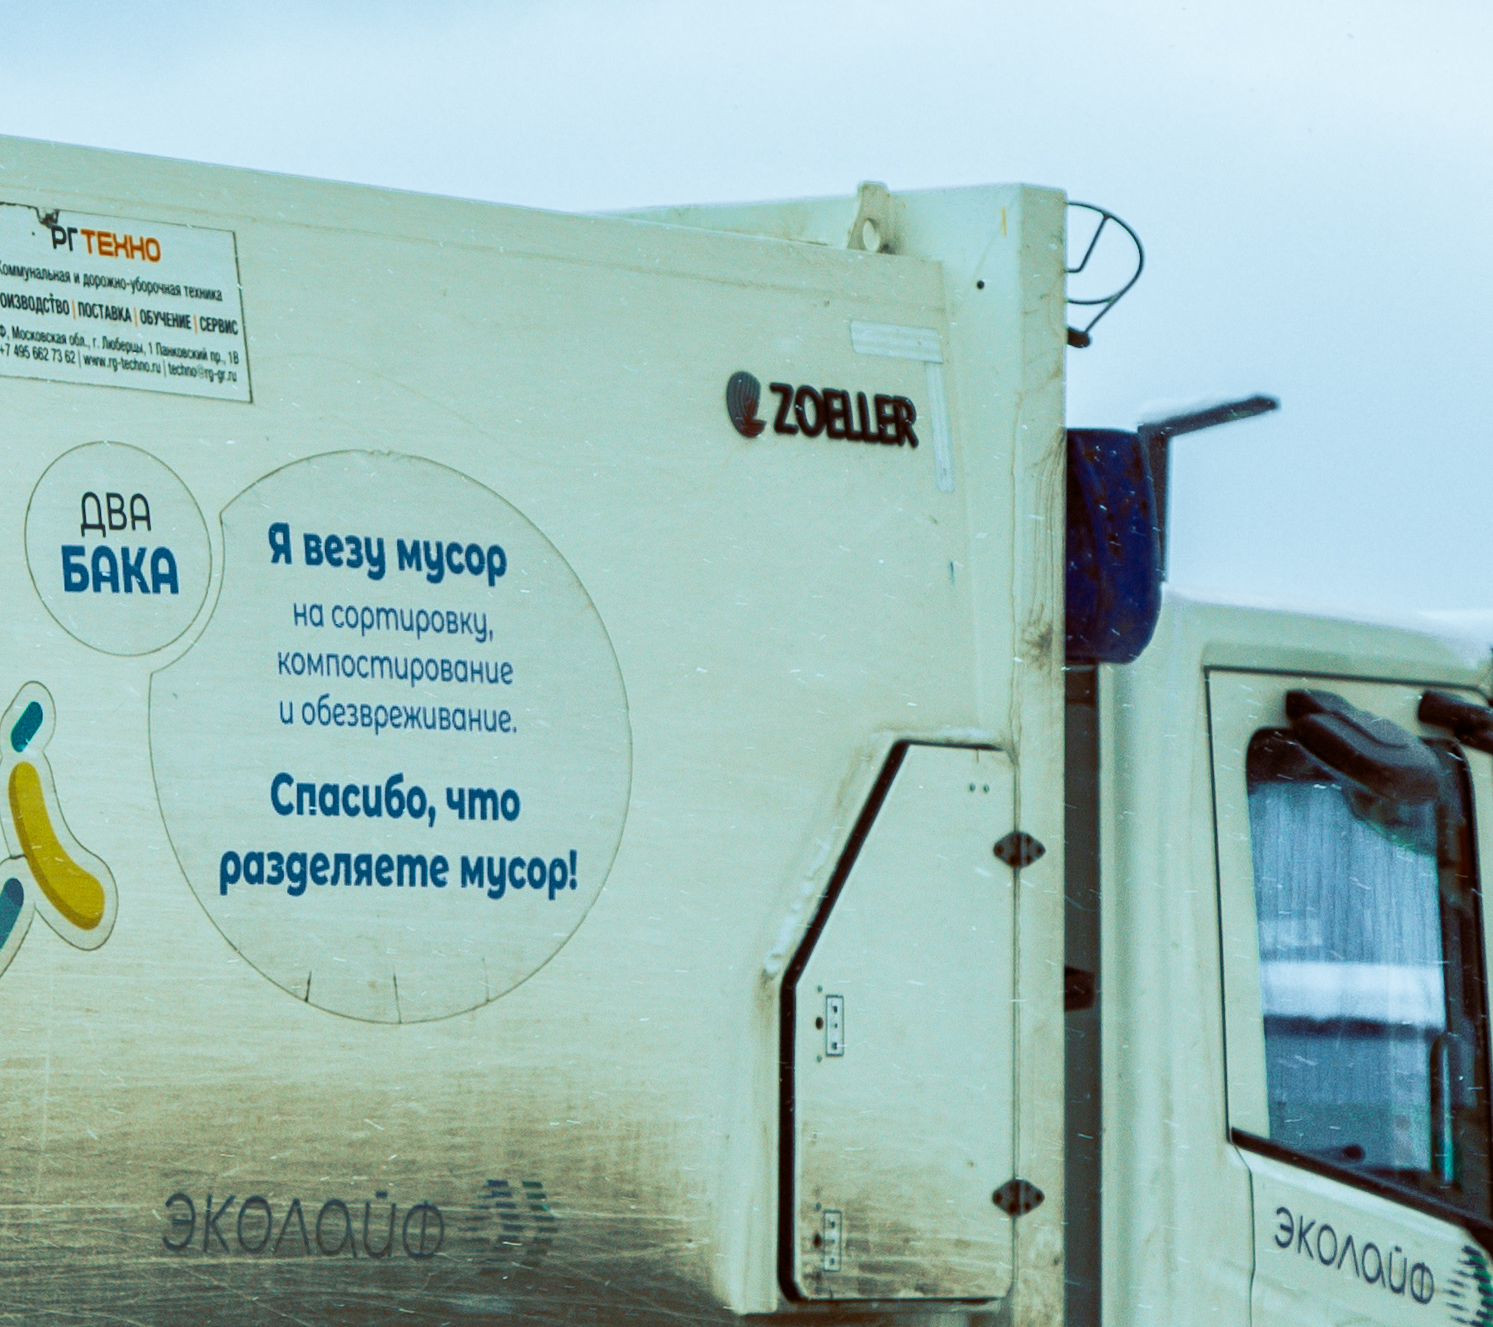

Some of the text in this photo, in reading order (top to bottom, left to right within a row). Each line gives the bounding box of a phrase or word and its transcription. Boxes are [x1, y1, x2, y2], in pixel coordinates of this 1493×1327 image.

[73, 272, 81, 284] и
[83, 273, 182, 297] дорожно-уборочная
[183, 285, 223, 302] техника
[78, 301, 132, 323] ПОСТАВКА
[139, 308, 192, 330] ОБУЧЕНИЕ
[199, 316, 239, 336] СЕРВИС
[0, 342, 11, 358] +7
[13, 344, 31, 360] 495
[32, 347, 49, 362] 662
[51, 348, 63, 364] 73
[64, 350, 76, 365] 62
[83, 354, 161, 374] www.rg-techno.ru
[11, 325, 67, 344] Московская
[92, 337, 101, 349] г.
[102, 335, 146, 356] Люберцы,
[148, 341, 153, 354] 1
[769, 382, 919, 448] ZOELLER
[80, 490, 152, 537] ДВА
[60, 543, 180, 595] БАКА
[268, 522, 508, 586] Я везу мусор
[292, 602, 494, 642] на сортировку,
[276, 650, 514, 688] компостирование
[278, 694, 518, 736] и обезвреживание.
[269, 772, 521, 828] Спасибо, что
[218, 850, 578, 900] разделяете мусор!
